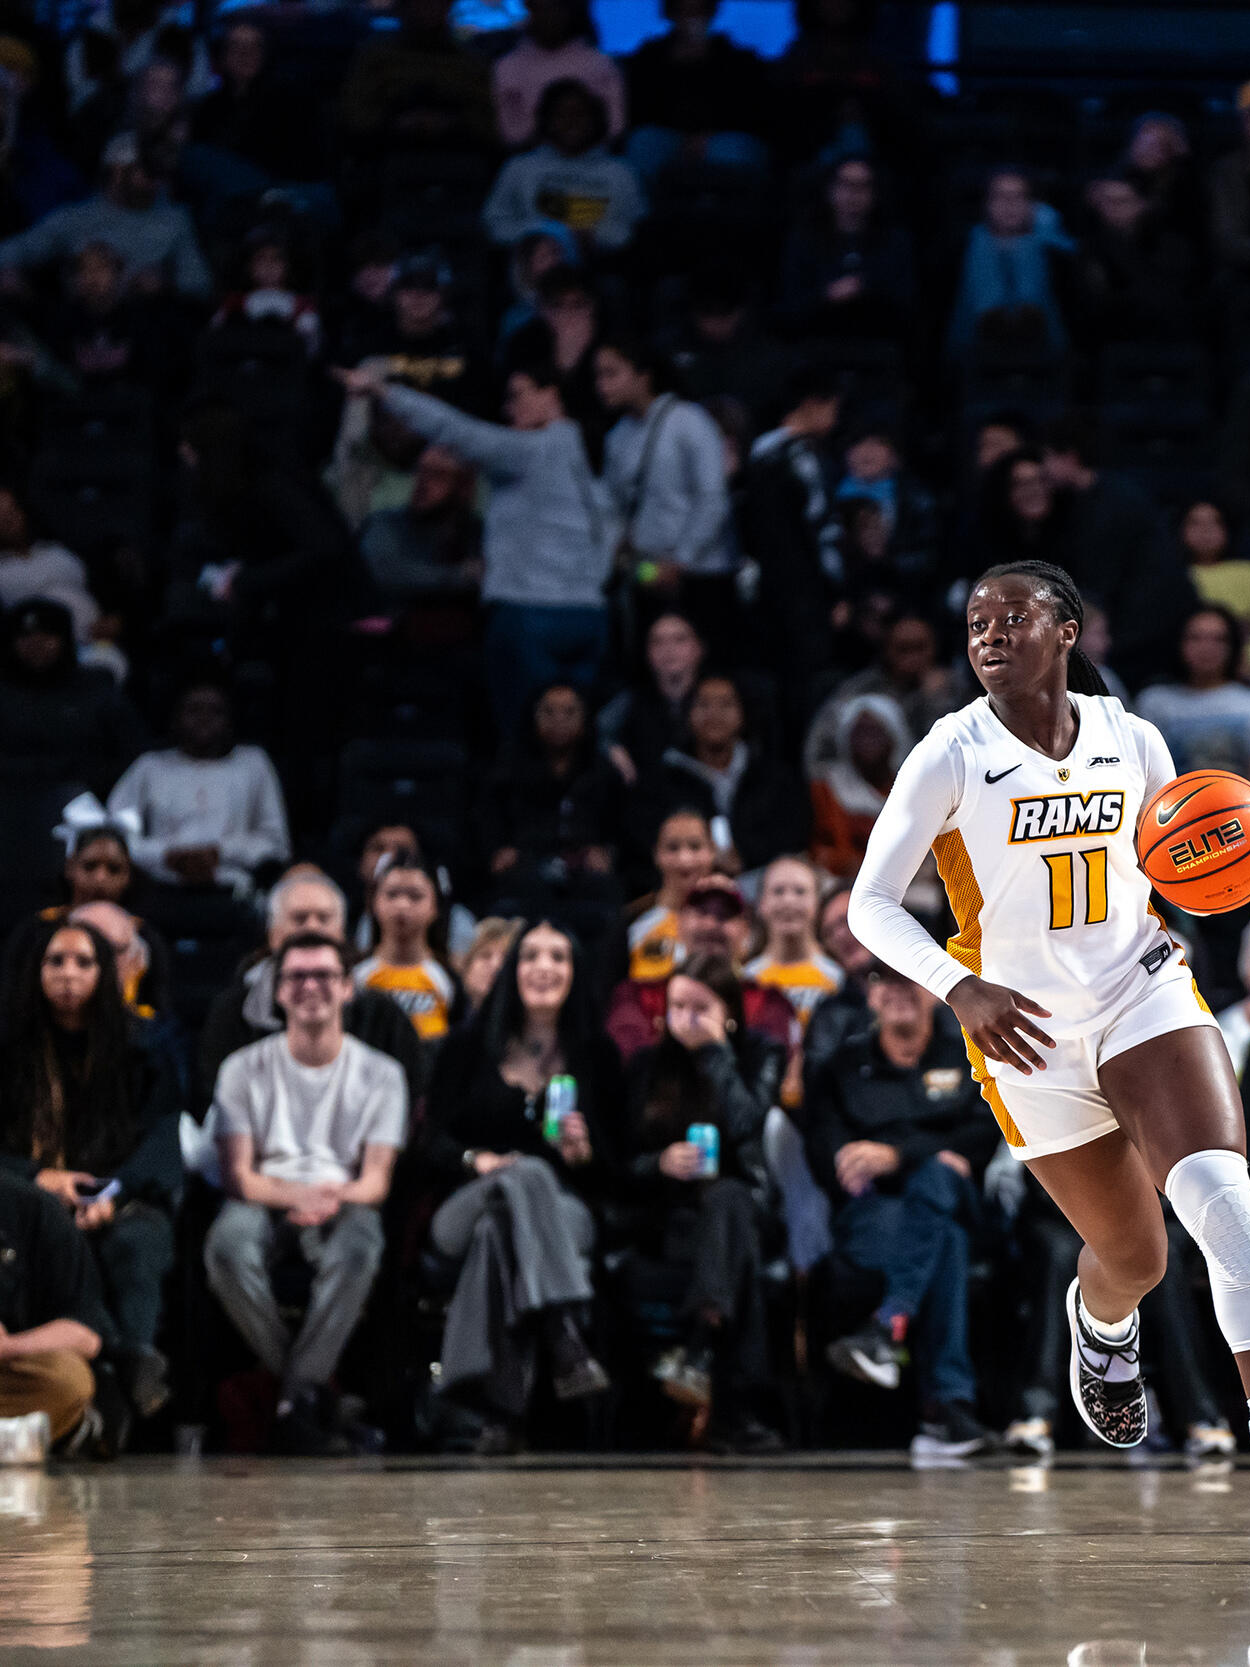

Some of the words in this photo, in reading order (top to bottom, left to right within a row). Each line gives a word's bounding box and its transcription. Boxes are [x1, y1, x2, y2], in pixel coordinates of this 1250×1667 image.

[1008, 790, 1125, 845] RAMS
[1168, 817, 1246, 867] ELITE
[1040, 846, 1108, 930] 11
